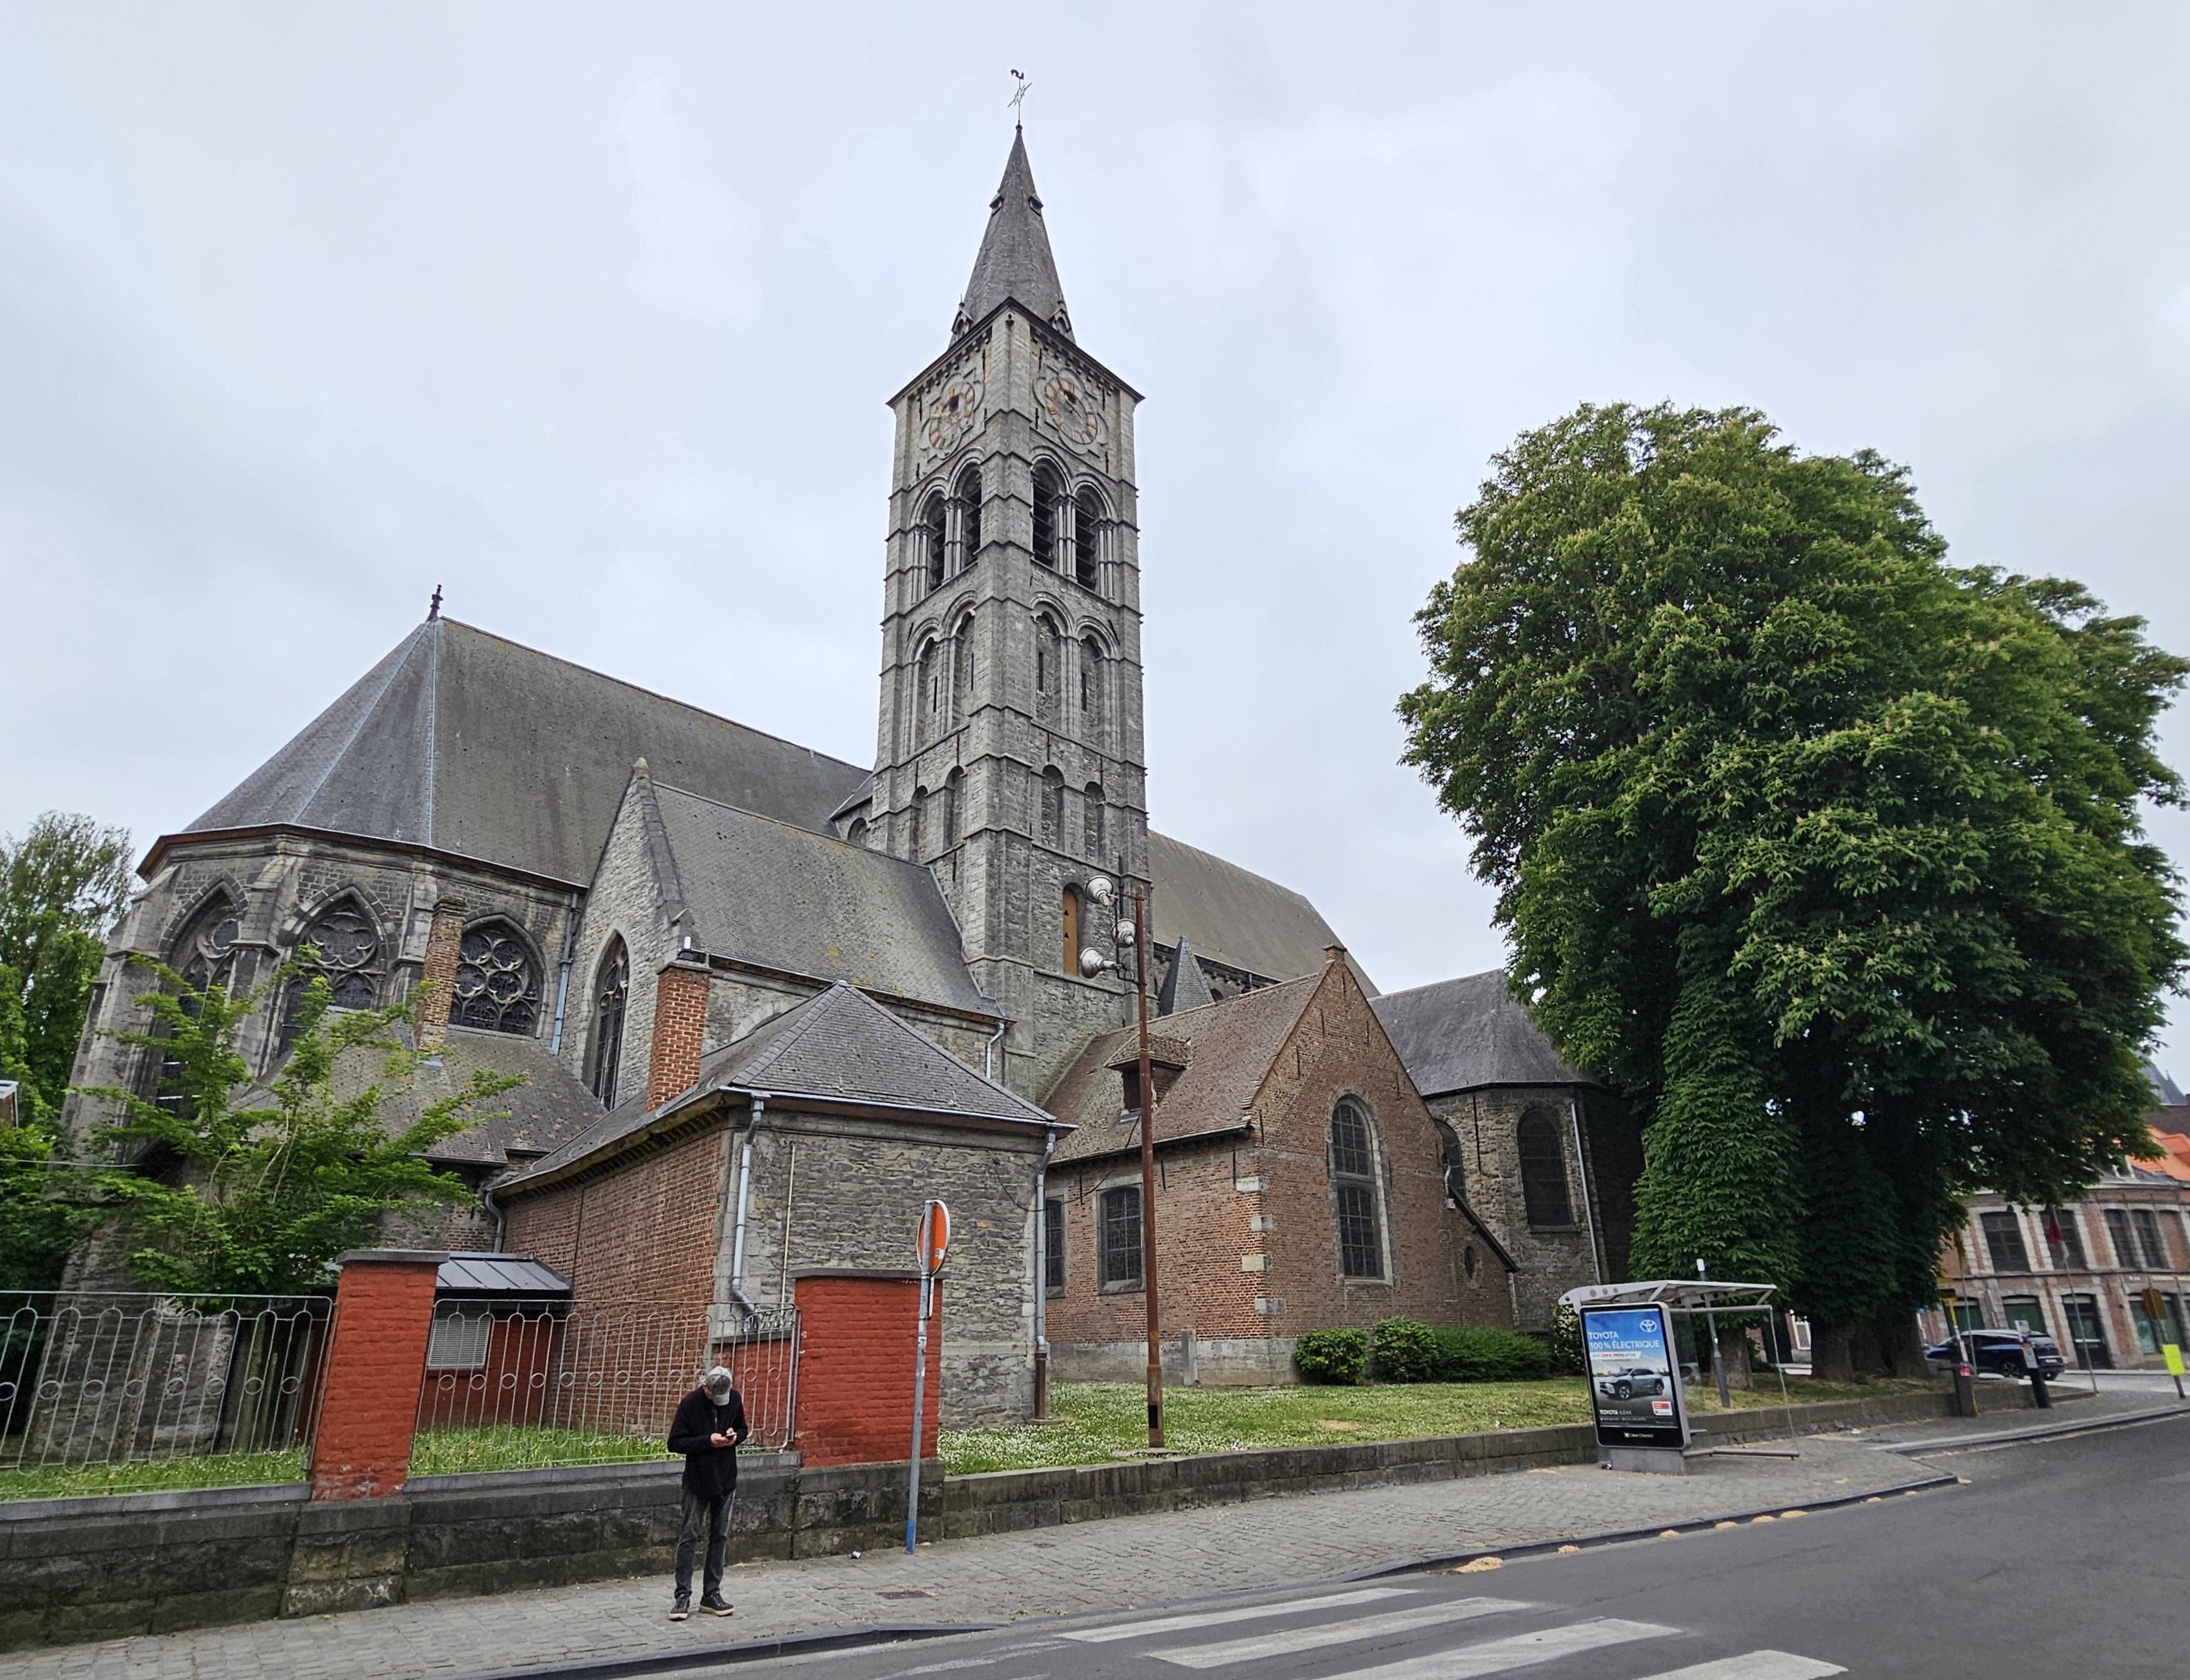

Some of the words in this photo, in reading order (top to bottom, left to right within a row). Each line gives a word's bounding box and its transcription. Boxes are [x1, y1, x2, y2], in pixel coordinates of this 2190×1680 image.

[1588, 1331, 1619, 1340] TOYOTA
[1590, 1341, 1603, 1350] 100
[1612, 1339, 1660, 1349] ÉLECTRIQUE
